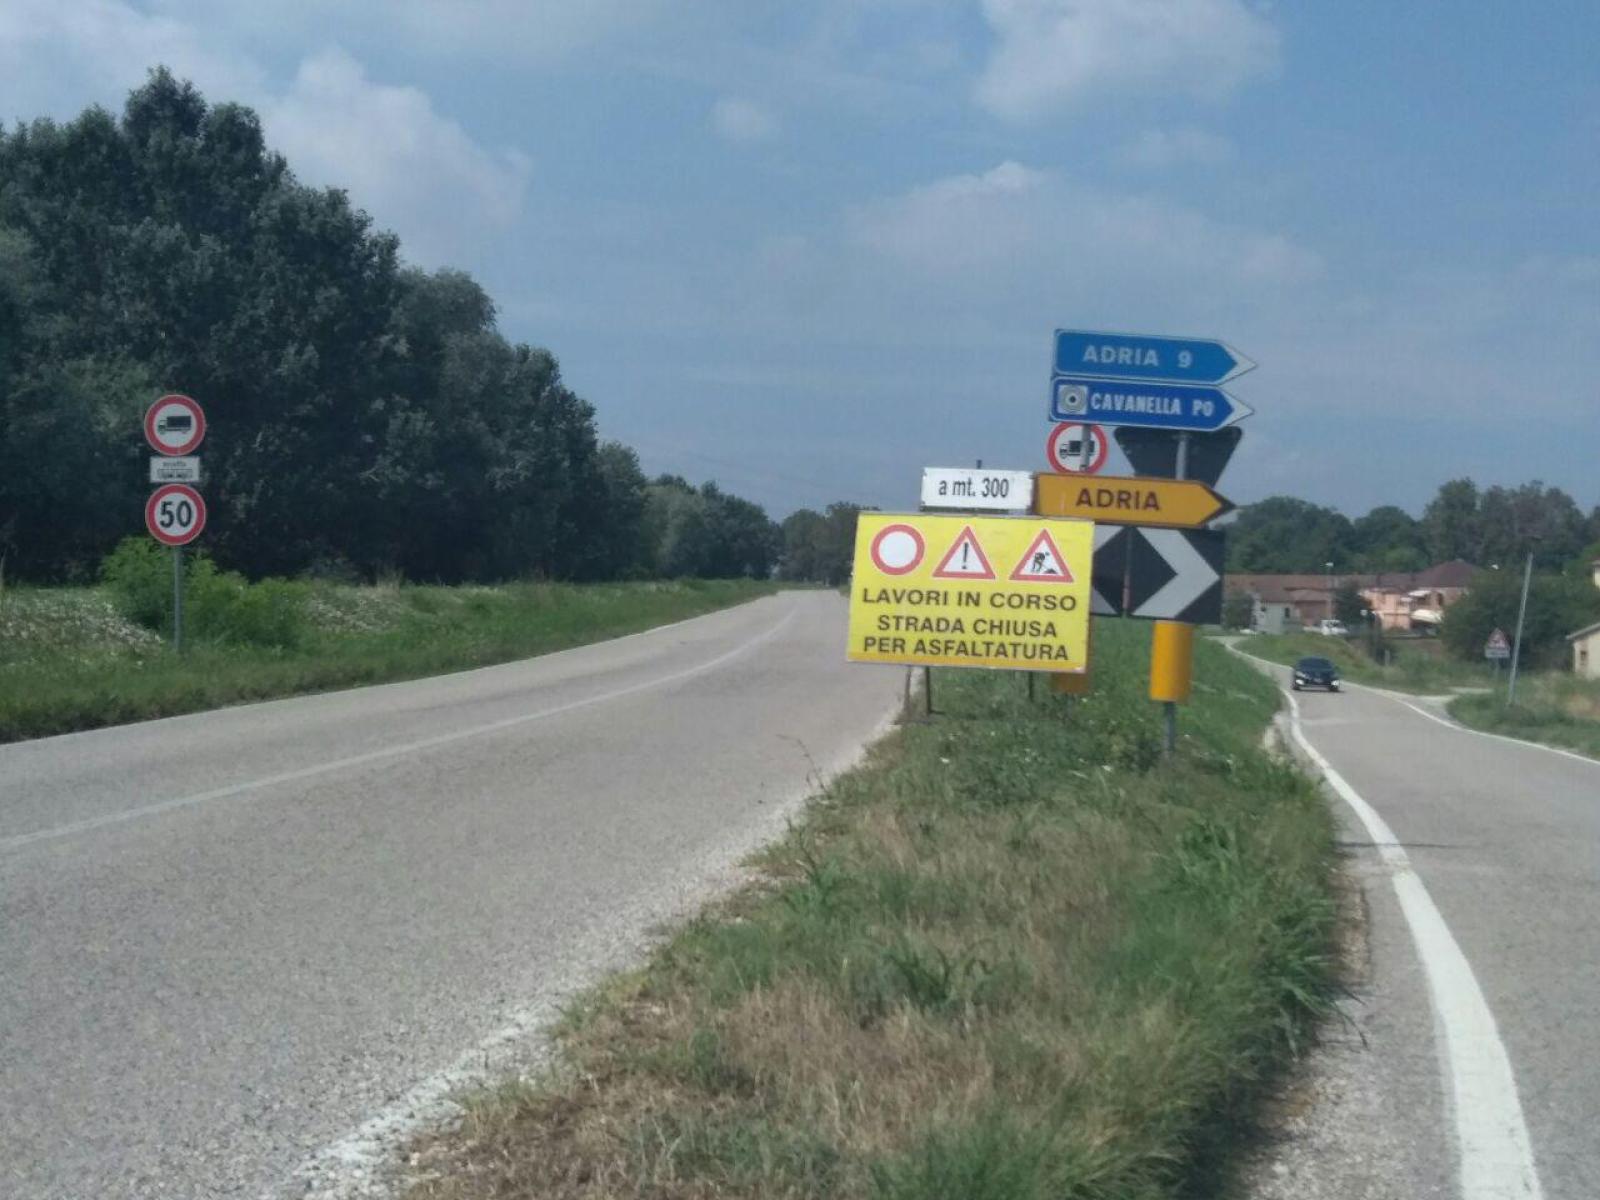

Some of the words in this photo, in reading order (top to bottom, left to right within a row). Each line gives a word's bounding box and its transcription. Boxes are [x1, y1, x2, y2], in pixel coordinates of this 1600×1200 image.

[1082, 345, 1159, 367] ADRIA
[1177, 349, 1193, 368] 9
[1090, 392, 1182, 415] CAVANELLA
[1192, 400, 1216, 417] PO
[939, 480, 948, 495] a
[951, 479, 976, 497] mt.
[981, 478, 1010, 498] 300
[1075, 488, 1161, 511] ADRIA
[159, 500, 192, 529] 50
[862, 588, 948, 606] LAVORI
[957, 591, 981, 607] IN
[989, 592, 1077, 611] CORSO
[877, 614, 965, 634] STRADA
[972, 618, 1057, 638] CHIUSA
[863, 636, 906, 654] PER
[913, 639, 1069, 661] ASFALTATURA
